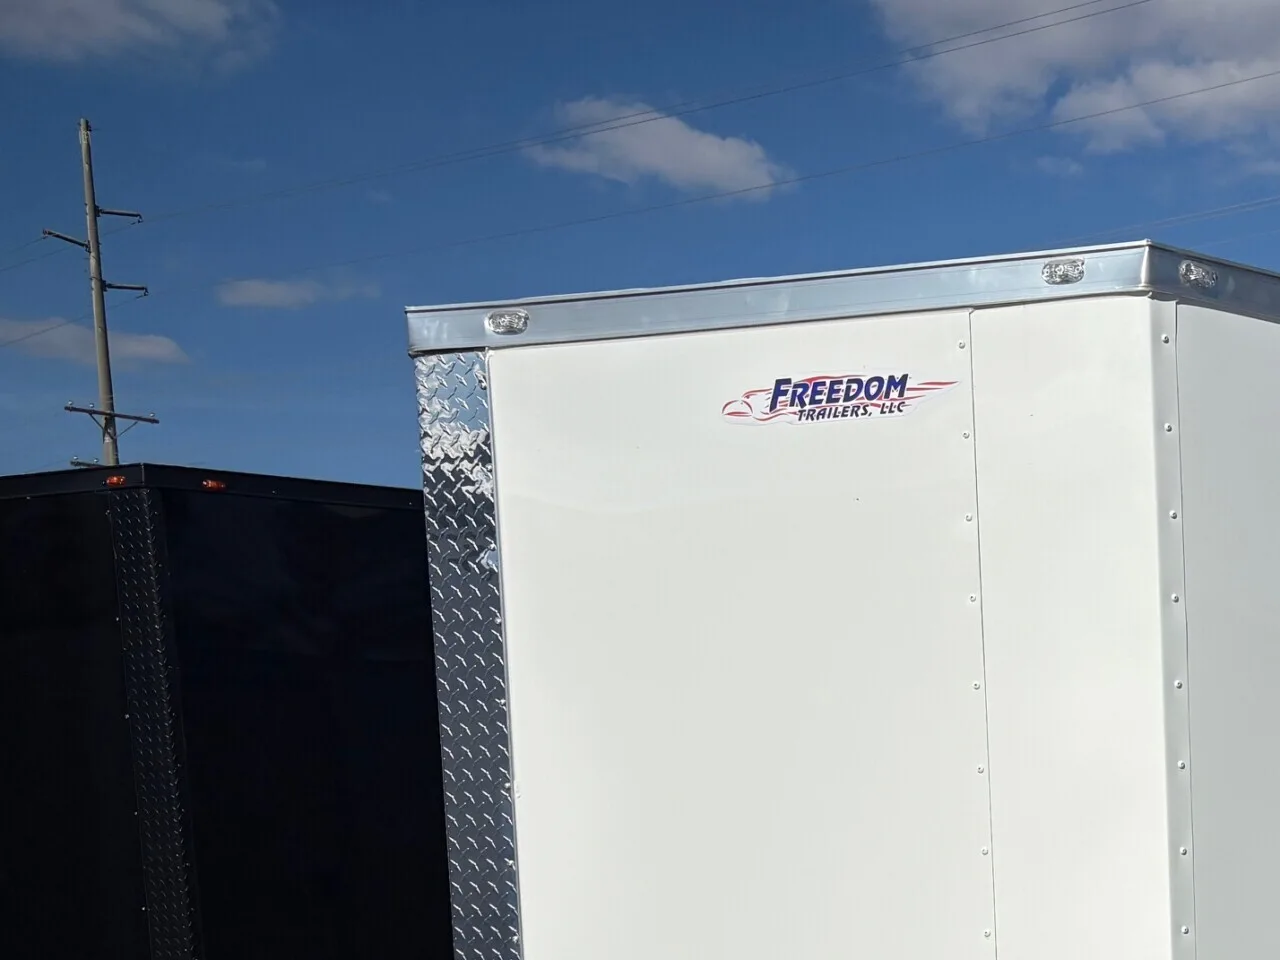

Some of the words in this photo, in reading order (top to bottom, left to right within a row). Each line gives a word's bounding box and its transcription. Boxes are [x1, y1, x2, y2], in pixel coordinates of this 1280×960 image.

[769, 374, 909, 413] FREEDOM
[797, 404, 873, 422] TRAILERS,
[880, 401, 906, 415] LLC
